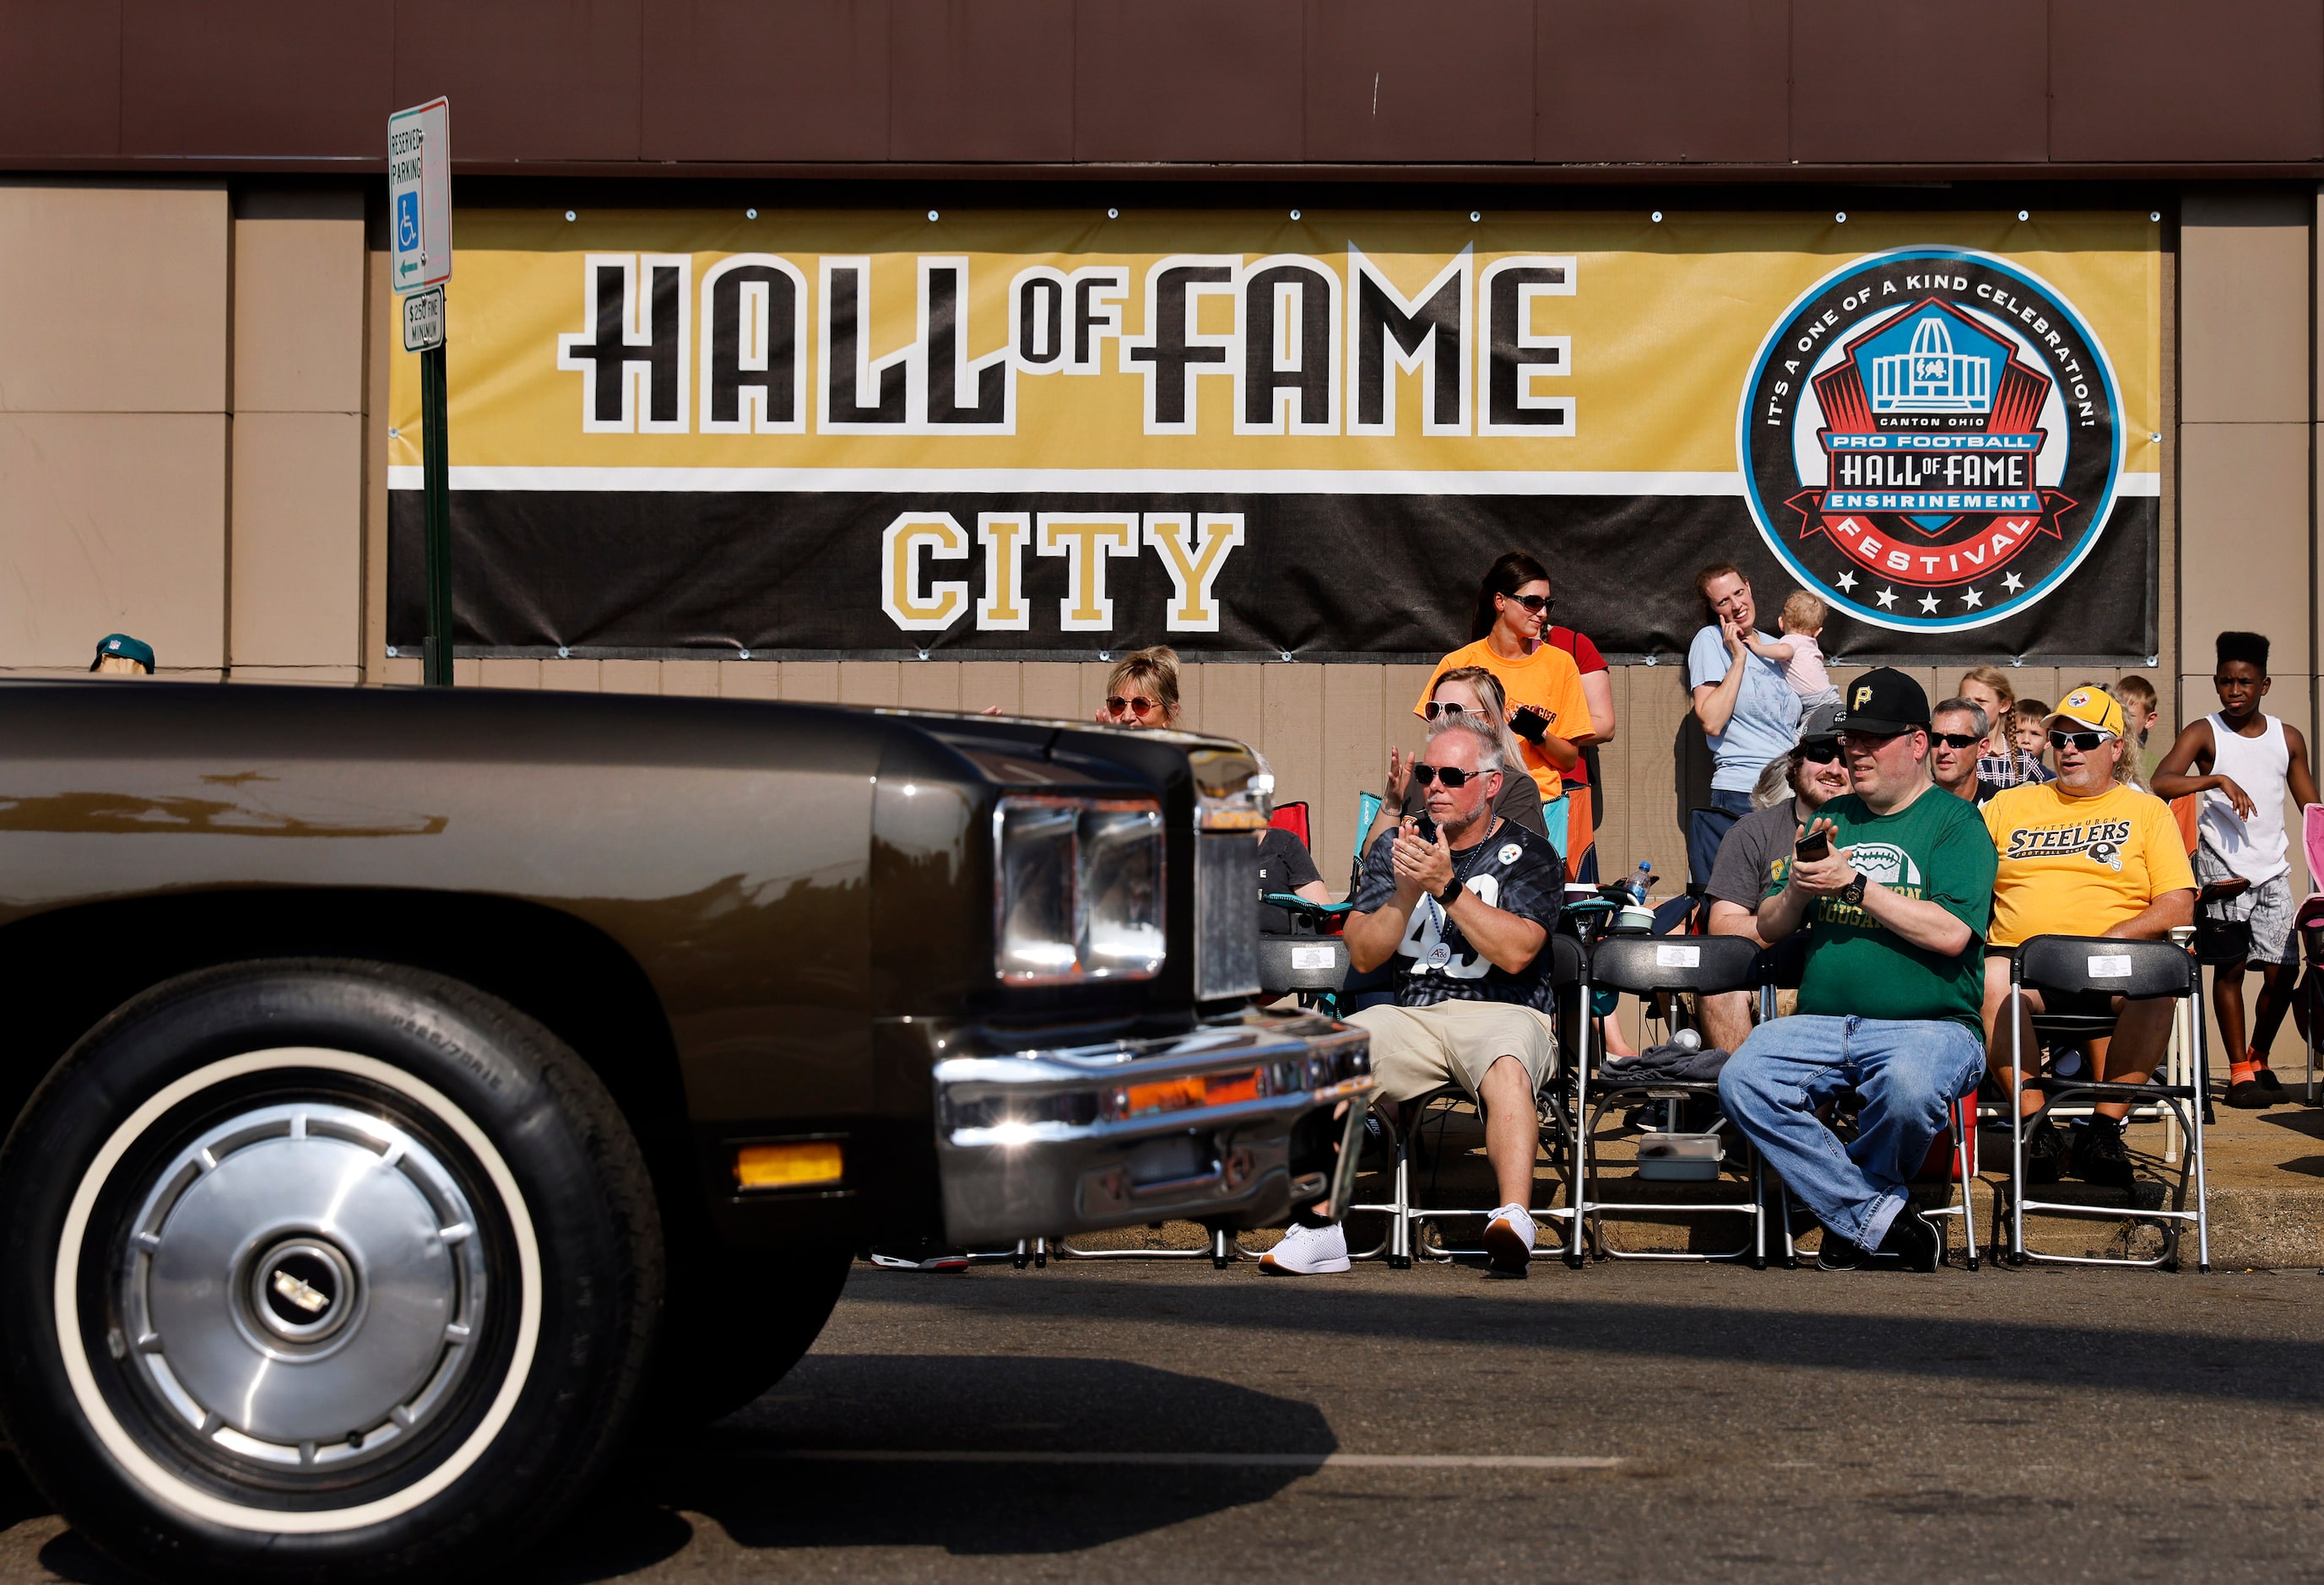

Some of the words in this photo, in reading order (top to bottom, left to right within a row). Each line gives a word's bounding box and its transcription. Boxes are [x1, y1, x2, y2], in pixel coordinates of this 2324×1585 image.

[392, 128, 421, 156] RESERVED
[393, 157, 421, 186] PARKING
[409, 300, 426, 323] $250
[427, 299, 438, 318] FINE
[411, 319, 437, 343] MINIMUM
[557, 252, 1016, 435] HALL
[1013, 264, 1129, 376] OF
[1119, 240, 1577, 437] FAME
[1767, 379, 1790, 426] IT'S
[1784, 359, 1801, 376] A
[1797, 309, 1839, 354] ONE
[1842, 287, 1873, 312] OF
[1882, 279, 1898, 295] A
[1905, 274, 1969, 292] KIND
[1976, 282, 2096, 428] CELEBRATION!
[1880, 417, 1944, 427] CANTON
[1948, 417, 1985, 427] OHIO
[1833, 435, 1888, 448] PRO
[1897, 435, 2031, 448] FOOTBALL
[1839, 454, 1922, 487] HALL
[1921, 457, 1942, 476] OF
[1942, 454, 2023, 487] FAME
[1830, 495, 2031, 508] ENSHRINEMENT
[1836, 517, 2030, 575] FESTIVAL
[881, 510, 1246, 632] CITY
[2007, 820, 2131, 853] STEELERS
[2034, 816, 2118, 831] PITTSBURGH
[2015, 849, 2061, 857] FOOTBALL
[1817, 901, 1884, 929] COUGA
